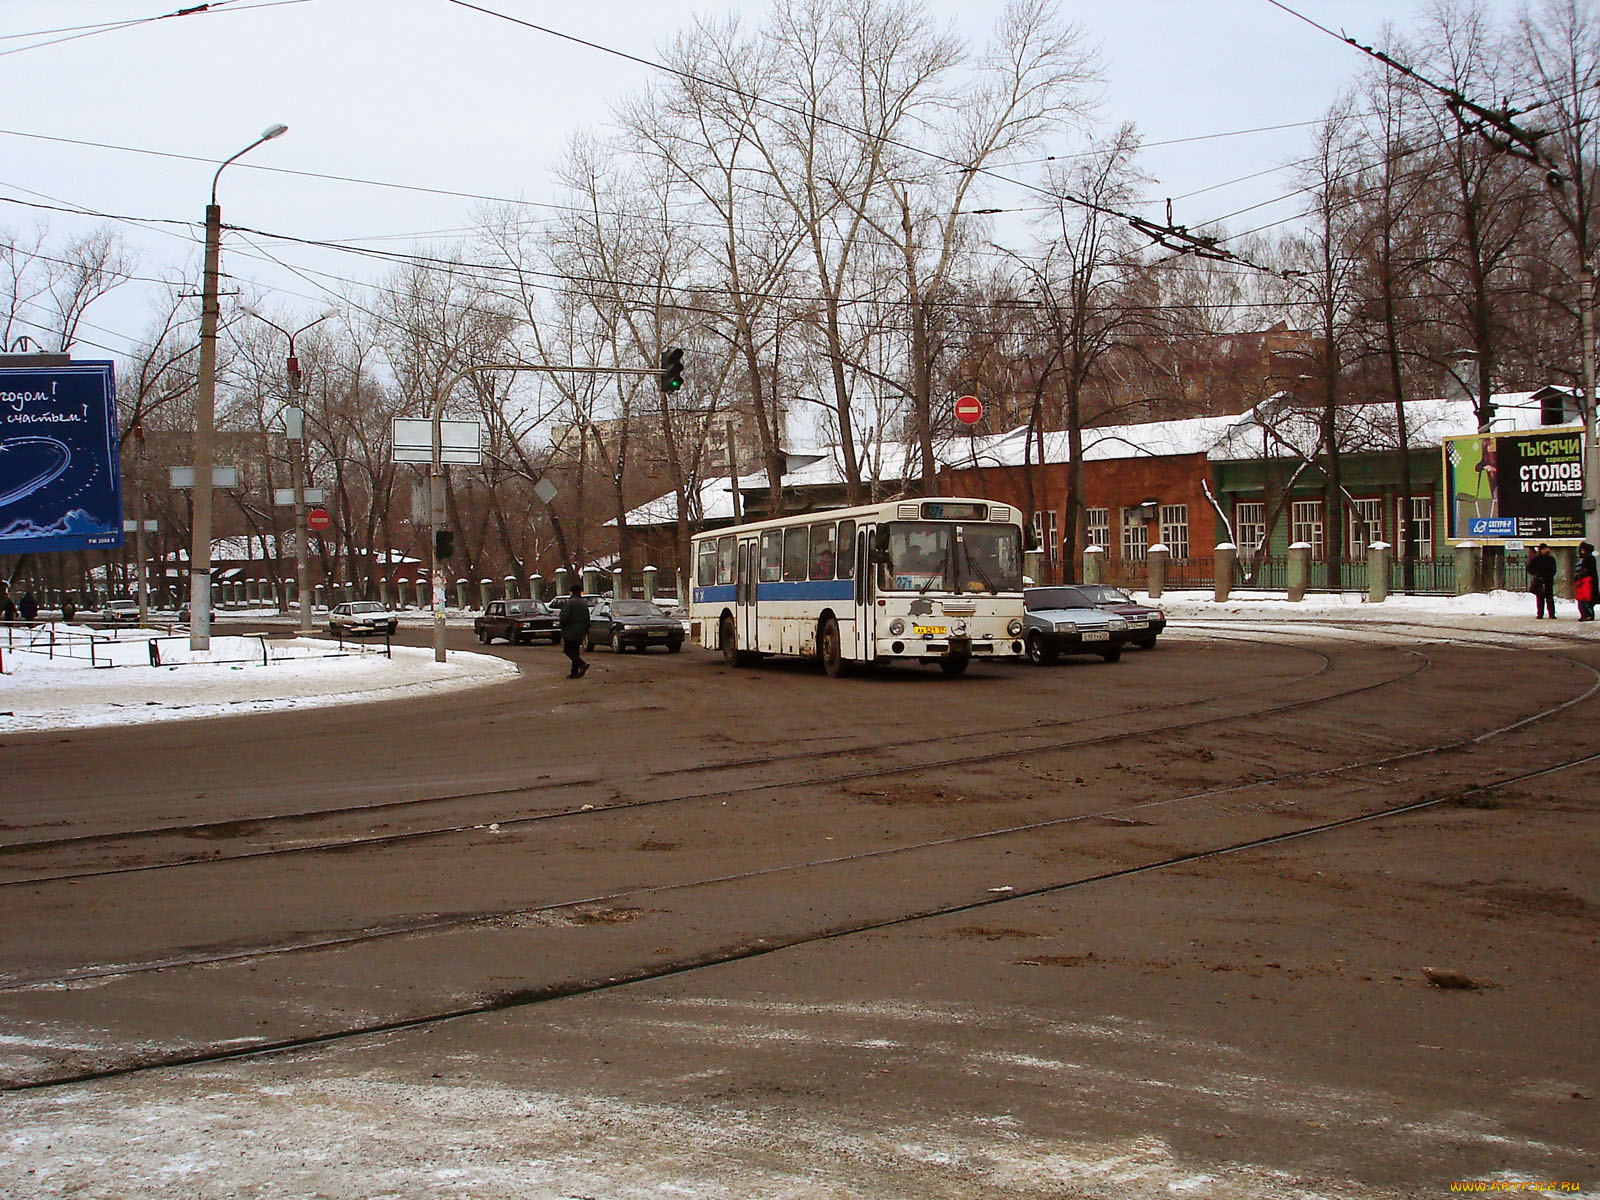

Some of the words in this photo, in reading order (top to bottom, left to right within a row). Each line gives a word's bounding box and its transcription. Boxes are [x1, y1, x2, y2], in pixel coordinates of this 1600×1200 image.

[7, 403, 88, 423] счастьем!
[1518, 439, 1580, 457] ТЫСЯЧИ
[1519, 463, 1582, 481] СТОЛОВ
[1521, 481, 1529, 492] И
[1531, 480, 1582, 492] СТУЛЬЕВ
